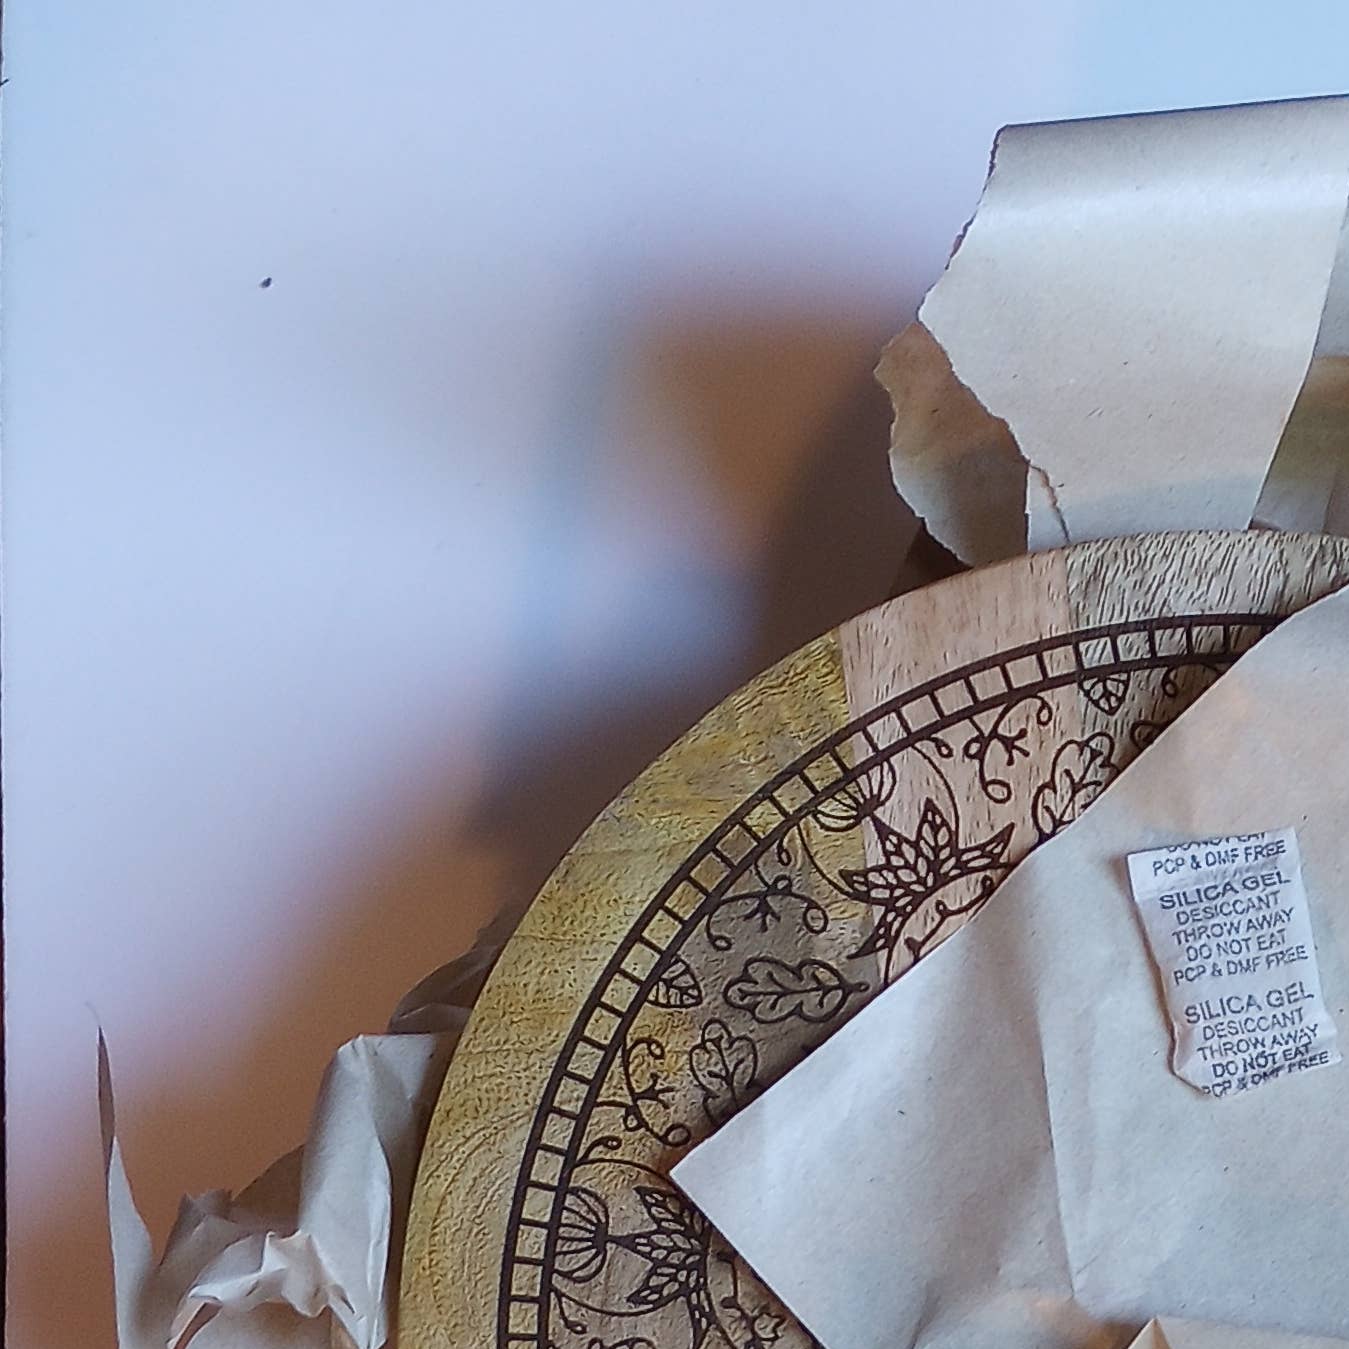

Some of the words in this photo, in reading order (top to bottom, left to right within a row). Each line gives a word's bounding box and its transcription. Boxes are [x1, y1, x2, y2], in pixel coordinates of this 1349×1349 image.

[1152, 856, 1185, 876] PCP
[1190, 854, 1202, 870] &
[1205, 847, 1239, 867] DMF
[1244, 839, 1287, 863] FREE
[1159, 881, 1239, 910] SILICA
[1241, 870, 1292, 891] GEL
[1176, 890, 1280, 925] DESICCANT
[1171, 920, 1241, 945] THROW
[1246, 907, 1294, 931] AWAY
[1186, 943, 1212, 962] DO
[1216, 937, 1252, 956] NOT
[1256, 928, 1287, 951] EAT
[1174, 964, 1207, 986] PCP
[1211, 962, 1223, 977] &
[1227, 955, 1262, 975] DMF
[1265, 945, 1308, 970] FREE
[1185, 994, 1263, 1024] SILICA
[1266, 981, 1315, 1008] GEL
[1197, 1037, 1266, 1061] THROW
[1271, 1023, 1319, 1047] AWAY
[1203, 1007, 1303, 1041] DESICCANT
[1212, 1060, 1238, 1078] DO
[1242, 1050, 1278, 1073] NOT
[1282, 1041, 1313, 1062] EAT
[1287, 1051, 1329, 1073] FREE
